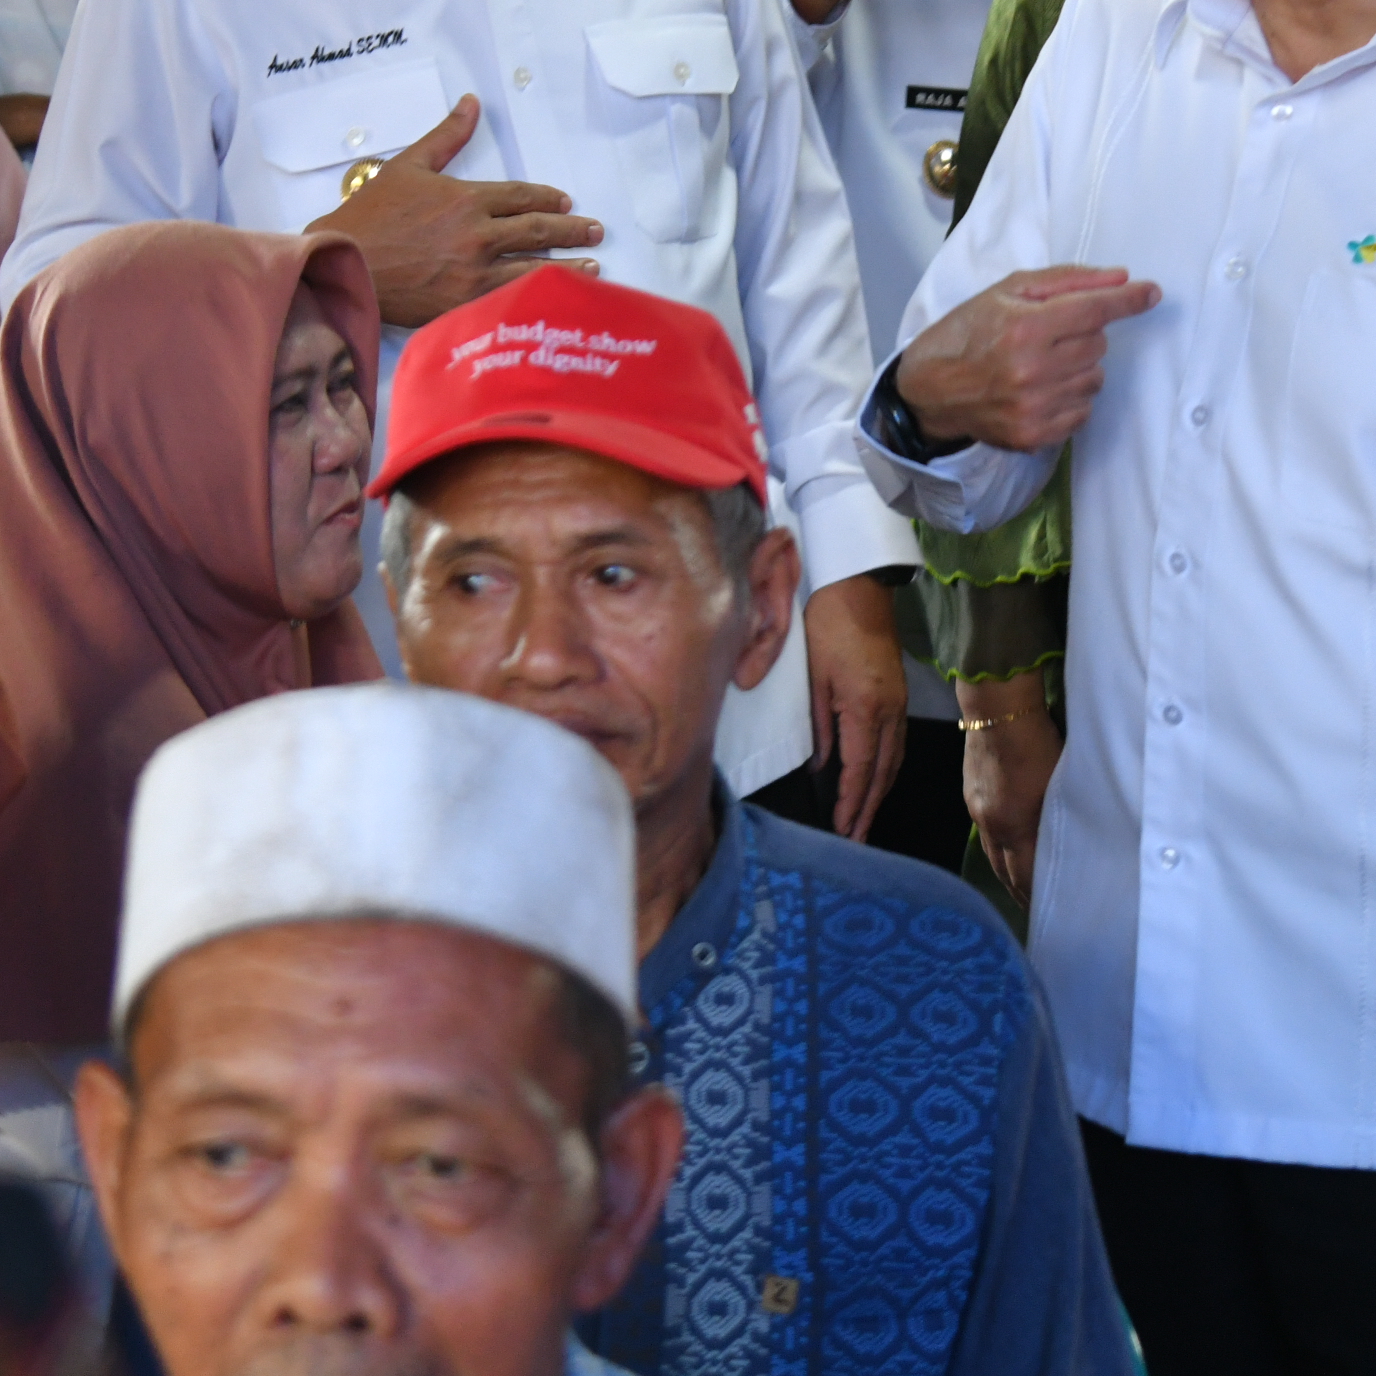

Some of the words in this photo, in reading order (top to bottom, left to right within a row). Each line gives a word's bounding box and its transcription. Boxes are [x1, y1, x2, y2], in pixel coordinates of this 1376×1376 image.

[915, 92, 953, 107] RAJA
[495, 319, 584, 348] budget
[586, 331, 658, 356] show
[470, 348, 526, 381] your
[528, 345, 621, 380] dignity
